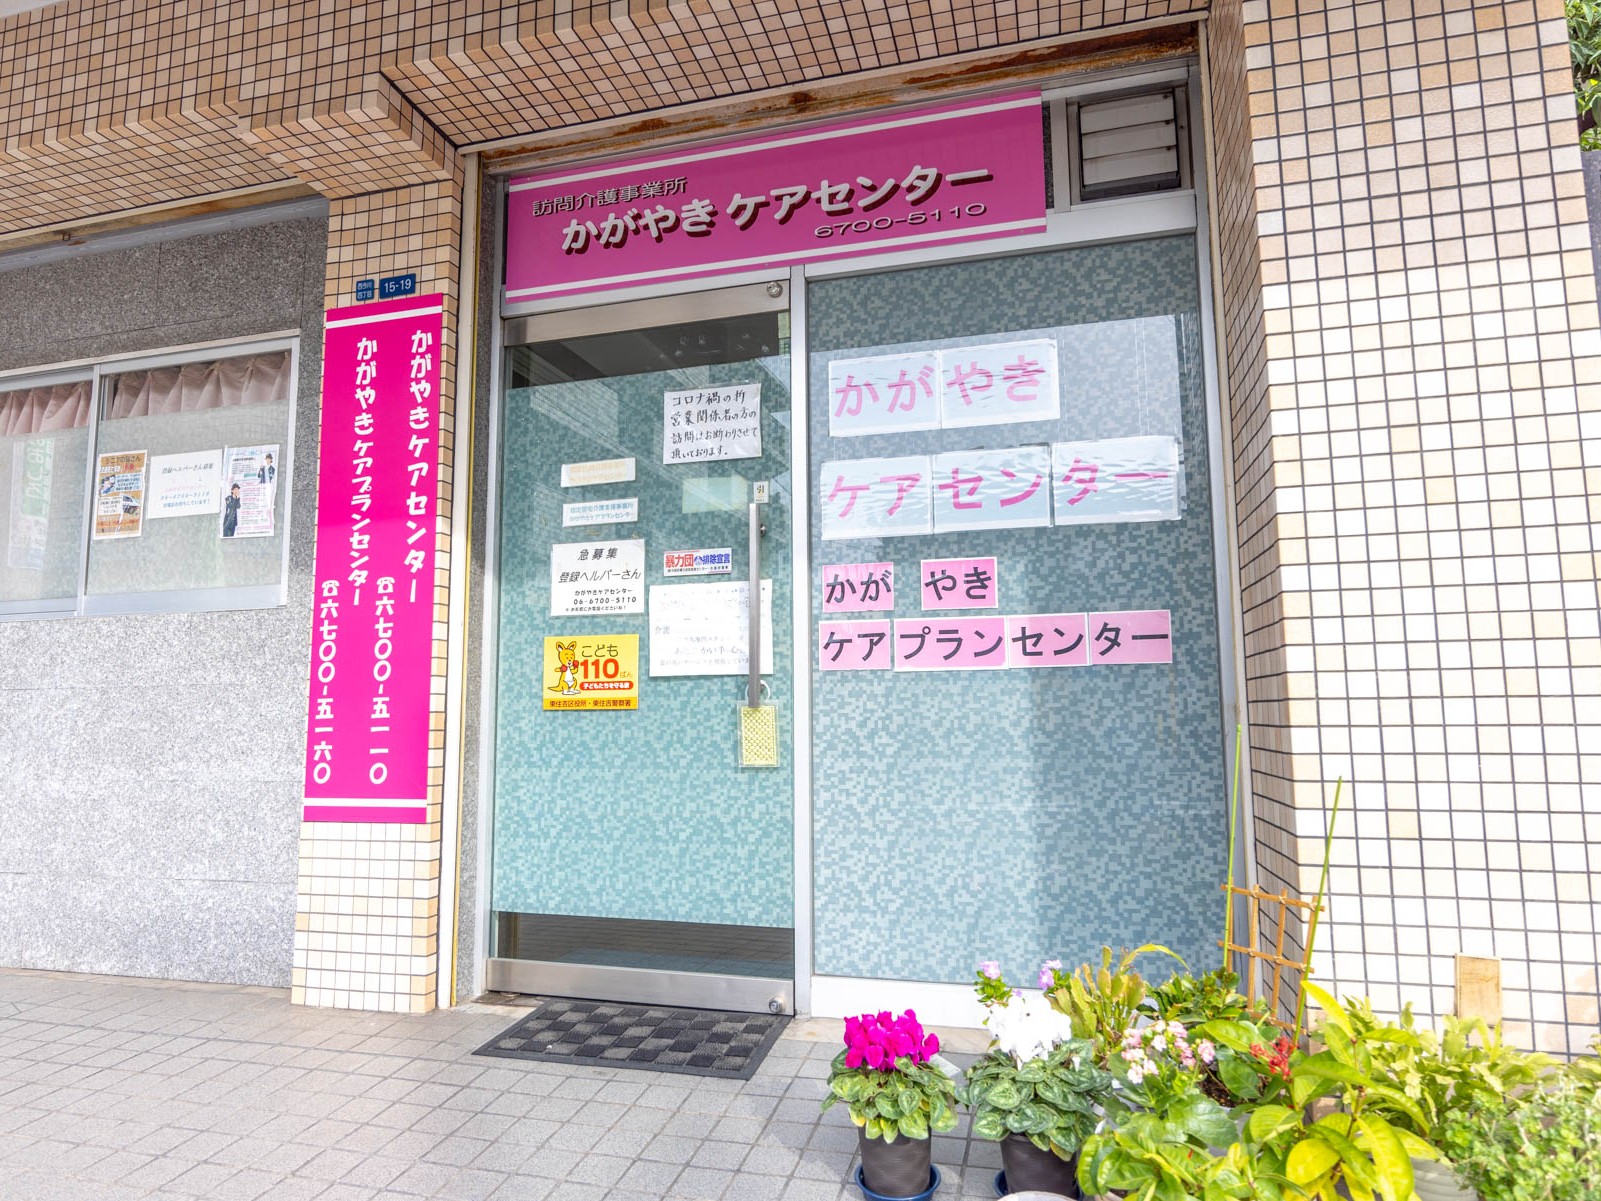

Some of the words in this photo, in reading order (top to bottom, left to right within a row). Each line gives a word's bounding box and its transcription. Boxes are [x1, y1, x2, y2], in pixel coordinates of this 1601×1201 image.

[532, 176, 688, 217] 訪問介護事業所
[561, 198, 718, 255] かがやき
[726, 164, 994, 231] ケアセンター
[814, 203, 987, 237] 6700-5110
[384, 278, 412, 293] 15-19
[834, 354, 1047, 418] かがやき
[347, 337, 378, 606] かがやきケアプランセンター
[403, 329, 433, 604] かがやきケアセンター
[827, 456, 1169, 518] ケアセンター
[577, 547, 619, 561] 急募集
[665, 553, 694, 568] 暴力団
[558, 568, 642, 584] 登録ヘルパーさん
[574, 588, 634, 597] かがやきケアセンター
[825, 569, 894, 605] かが
[924, 566, 993, 602] やき
[573, 596, 637, 605] 06-6700-5110
[581, 644, 619, 659] こども
